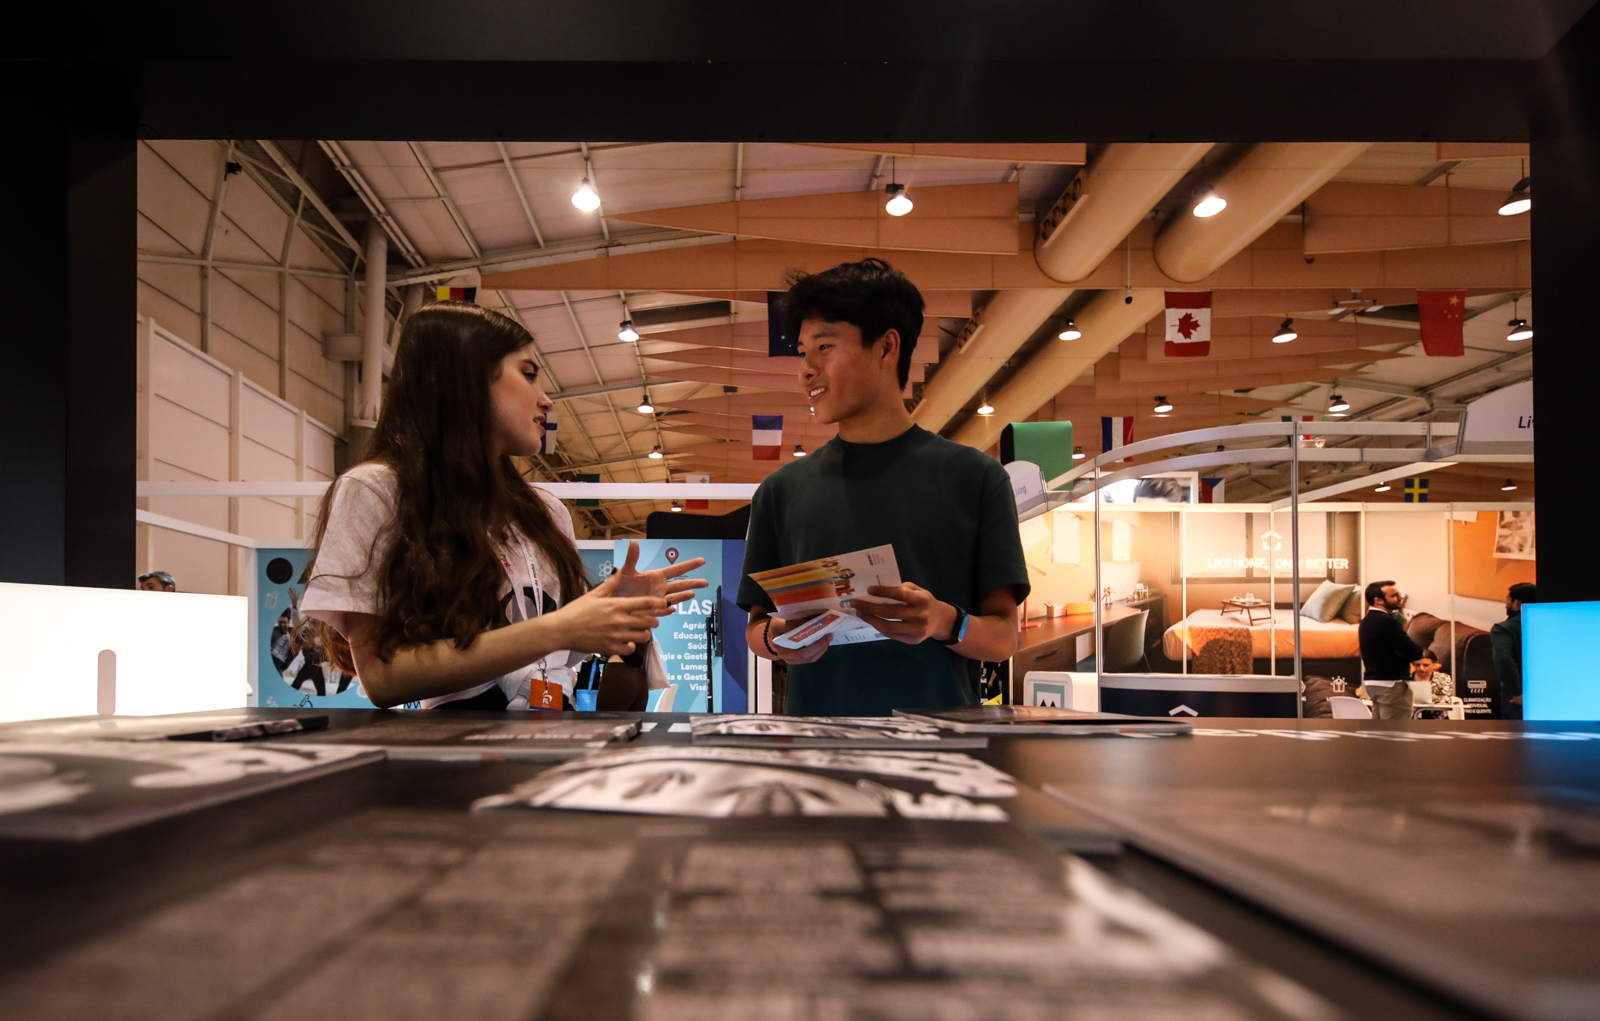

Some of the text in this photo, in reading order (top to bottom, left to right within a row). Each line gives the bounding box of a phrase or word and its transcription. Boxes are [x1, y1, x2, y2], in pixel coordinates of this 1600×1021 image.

[1518, 415, 1533, 429] Li
[1207, 557, 1349, 570] LIKE HOME, ONY BETTER
[682, 622, 714, 630] Agrár
[673, 631, 713, 641] Educaçã
[687, 642, 713, 650] Saúd
[683, 652, 713, 660] Gestã
[680, 663, 713, 672] Lameg
[683, 673, 709, 681] Gestã
[689, 683, 709, 691] Vise
